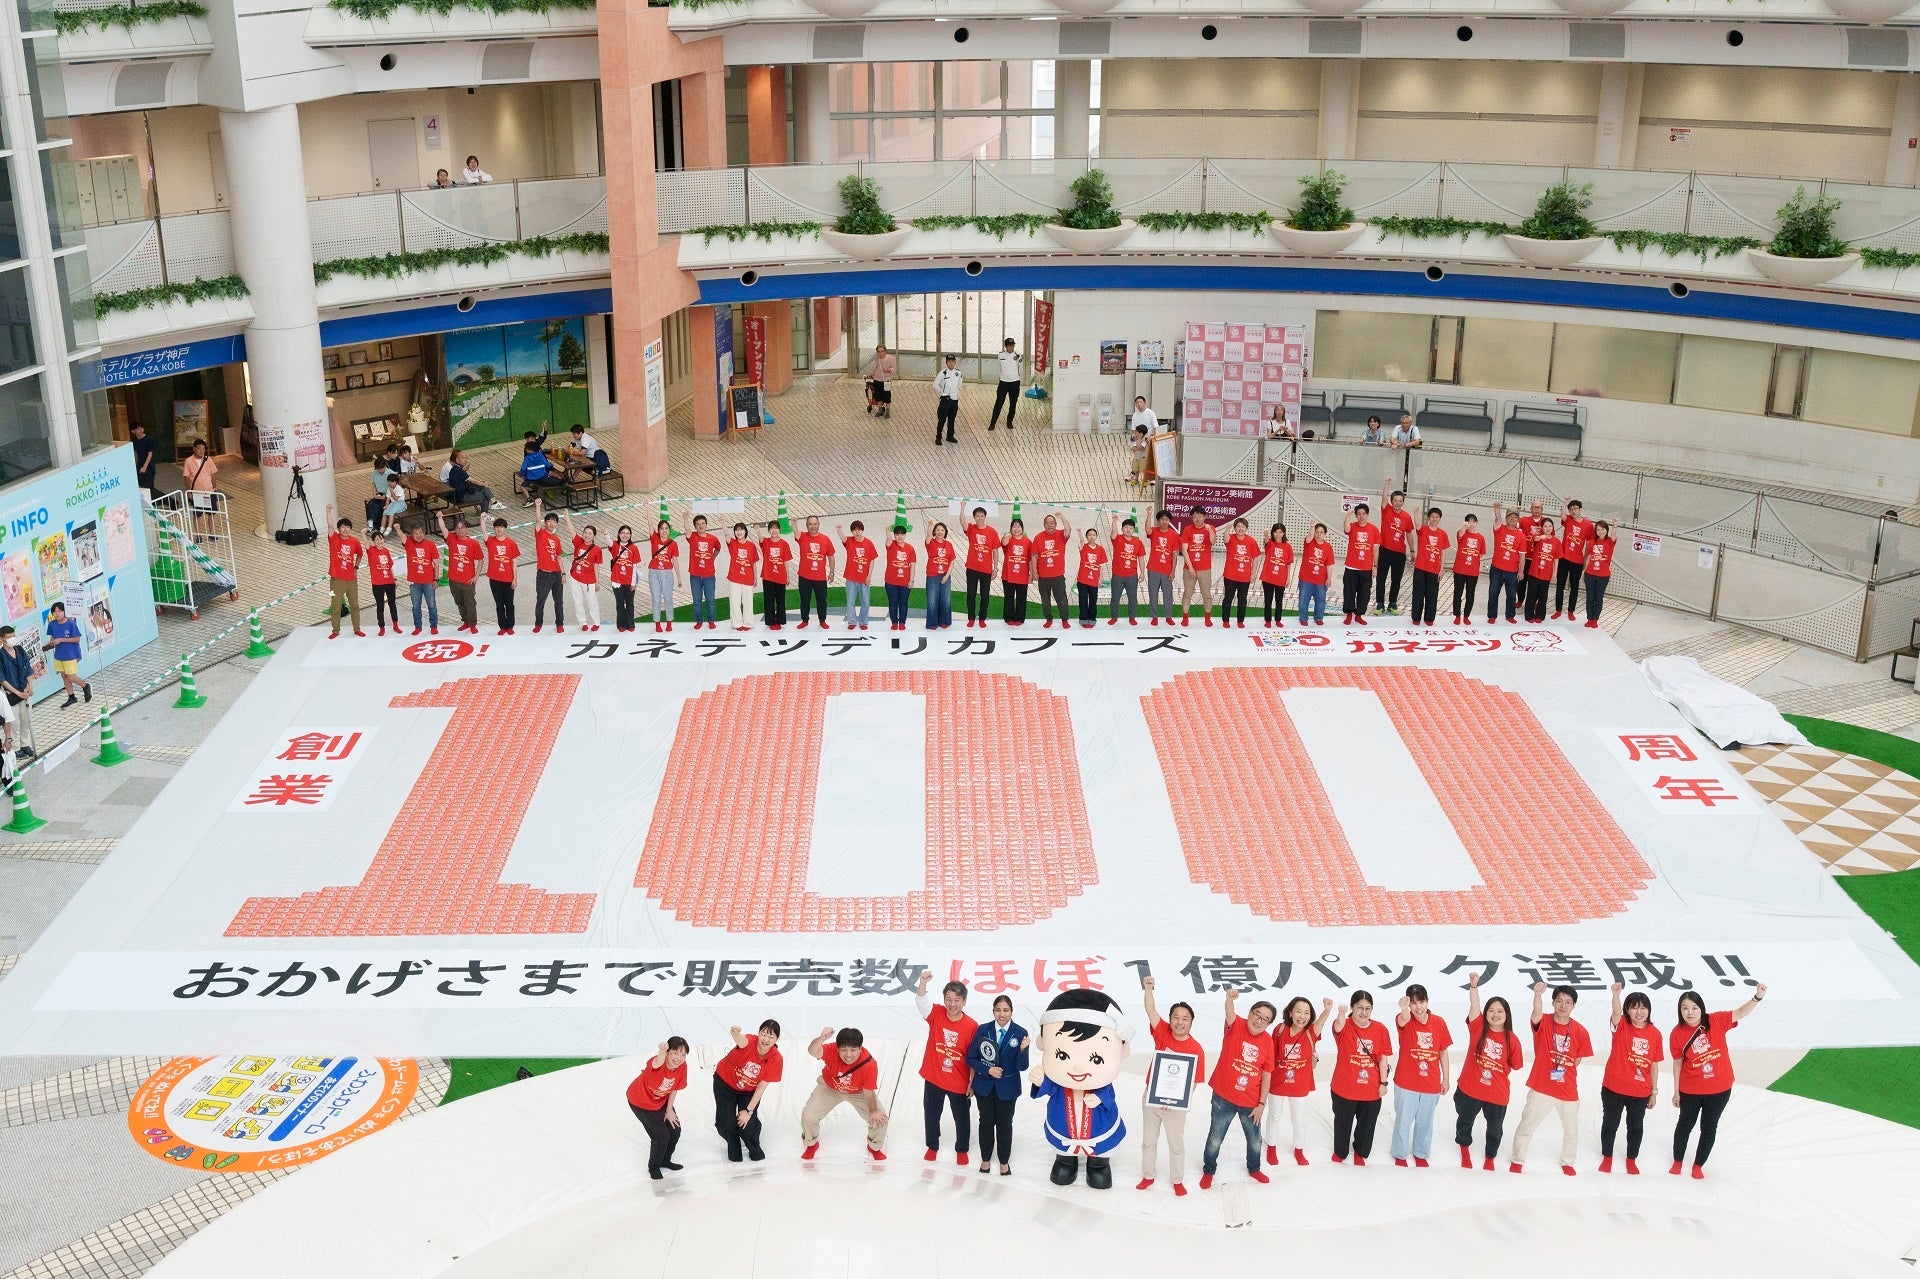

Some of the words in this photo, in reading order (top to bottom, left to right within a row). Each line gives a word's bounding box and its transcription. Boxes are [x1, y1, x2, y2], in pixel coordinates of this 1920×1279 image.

[427, 118, 437, 130] 4
[95, 346, 190, 374] ホテルプラザ神戸
[100, 371, 129, 385] HOTEL
[131, 365, 160, 378] PLAZA
[161, 360, 186, 372] KOBE
[65, 487, 95, 509] ROKKO
[100, 476, 121, 494] PARK
[1166, 486, 1254, 499] 神戸ファッション美術館
[11, 506, 49, 538] INFO
[565, 633, 1191, 659] カネテツデリカフーズ
[1346, 639, 1502, 653] カネテツ
[243, 731, 363, 806] 創業
[1618, 734, 1740, 807] 周年
[292, 1076, 337, 1122] あそびのマナー
[303, 1069, 377, 1135] ふわふわドーム
